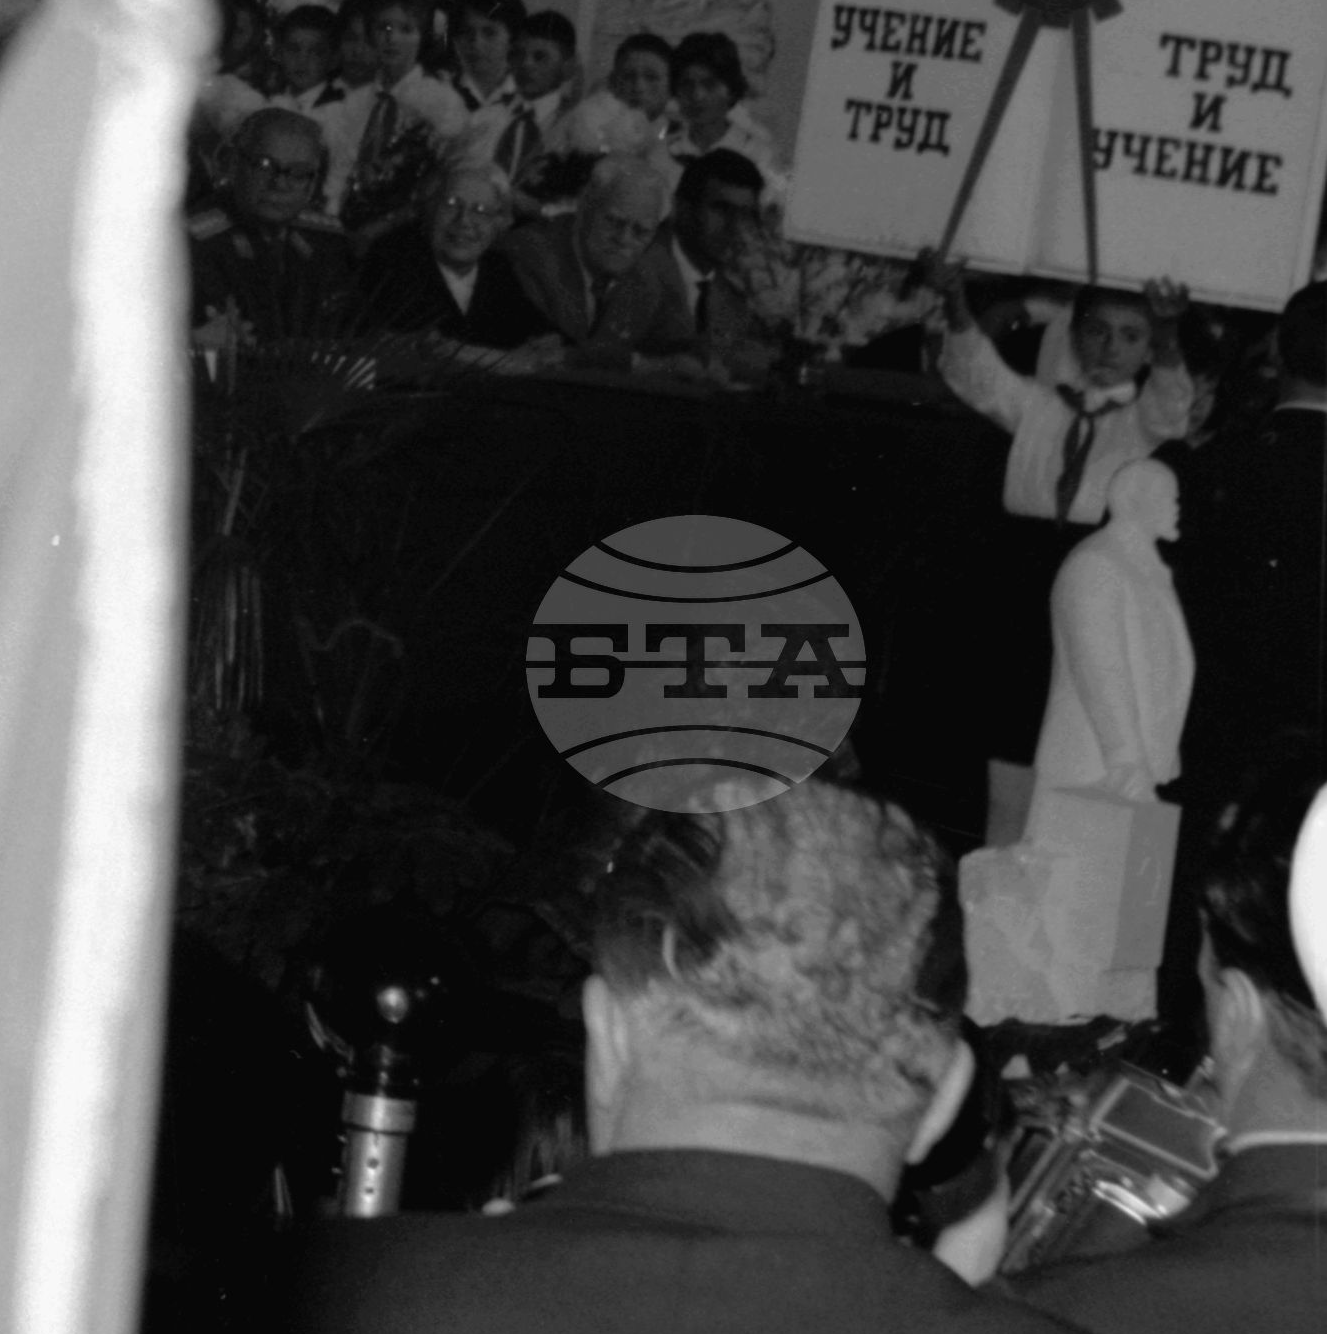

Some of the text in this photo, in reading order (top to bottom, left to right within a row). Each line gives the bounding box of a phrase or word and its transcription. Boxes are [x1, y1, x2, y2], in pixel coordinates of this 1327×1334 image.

[831, 4, 987, 63] УЧЕНИЕ
[886, 61, 919, 101] И
[1159, 33, 1293, 99] ТРУД
[845, 98, 952, 156] ТРУД
[1189, 92, 1229, 133] И
[1091, 127, 1283, 196] УЧЕНИЕ
